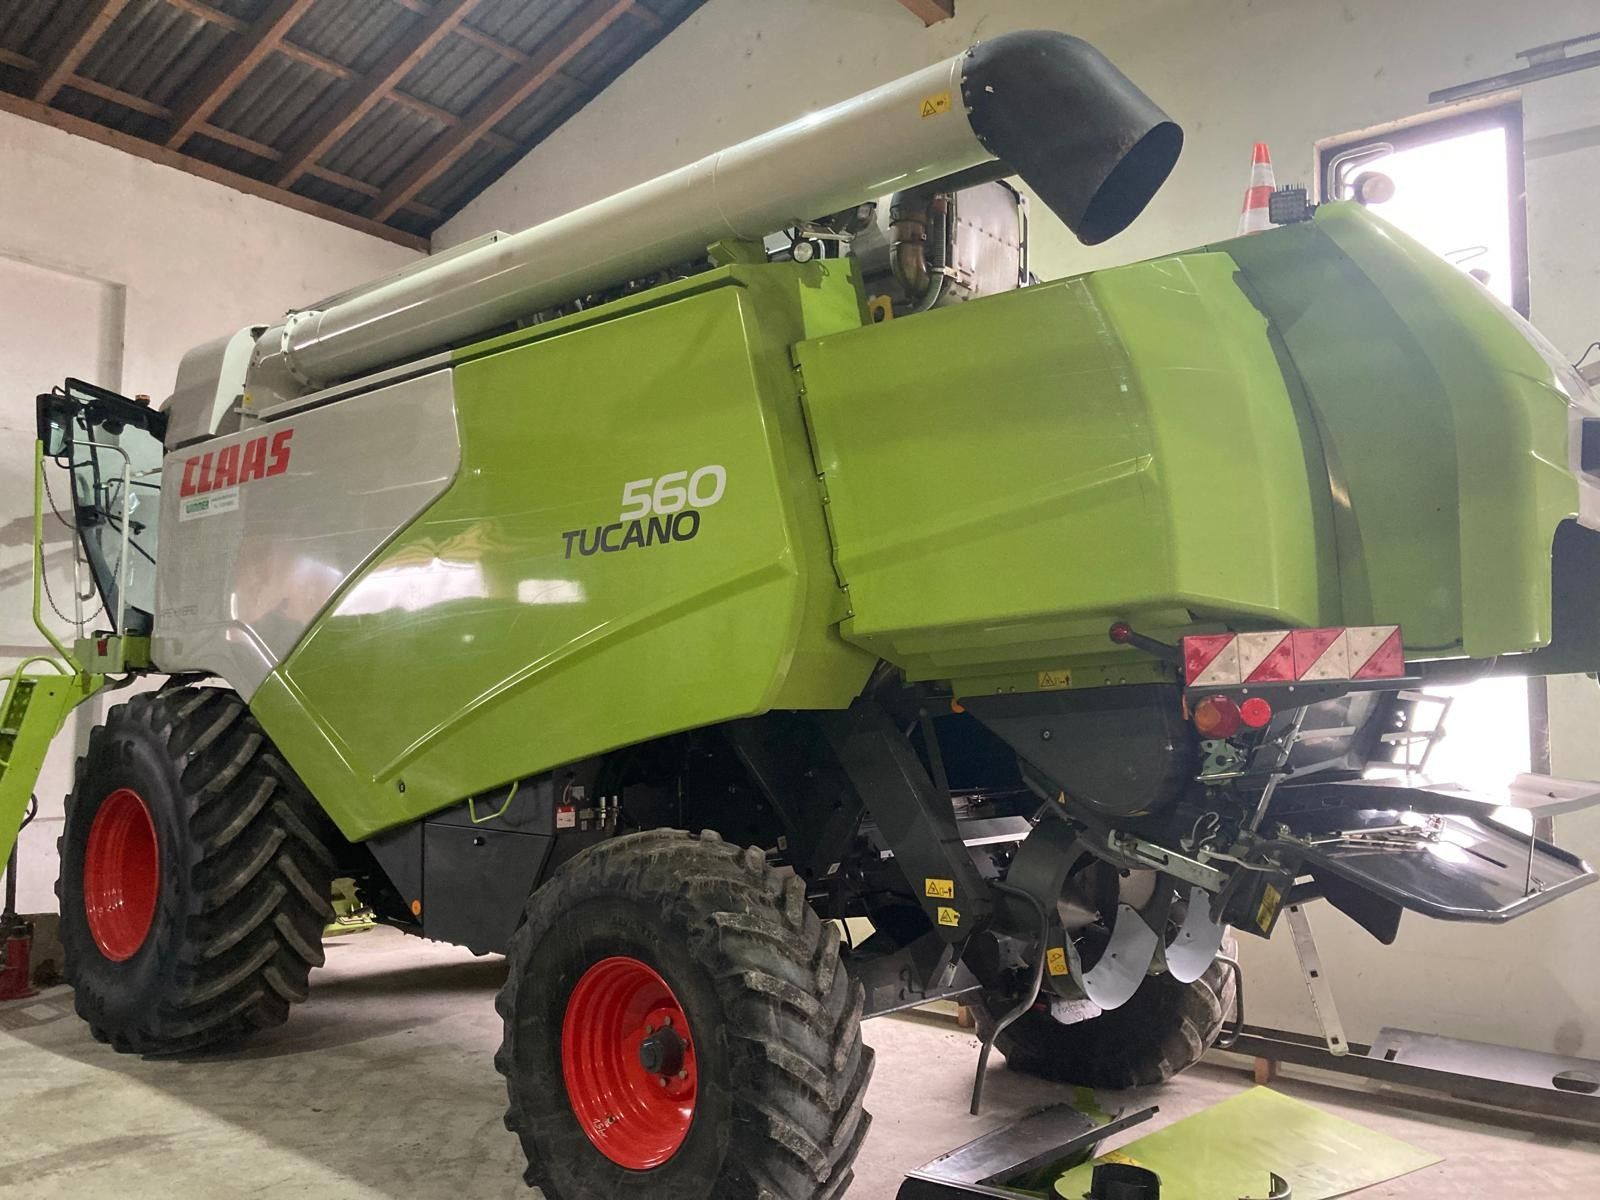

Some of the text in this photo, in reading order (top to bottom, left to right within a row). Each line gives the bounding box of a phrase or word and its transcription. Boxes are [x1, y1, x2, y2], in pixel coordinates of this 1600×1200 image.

[180, 428, 294, 497] CLAAS
[619, 464, 727, 522] 560
[562, 510, 700, 560] TUCANO
